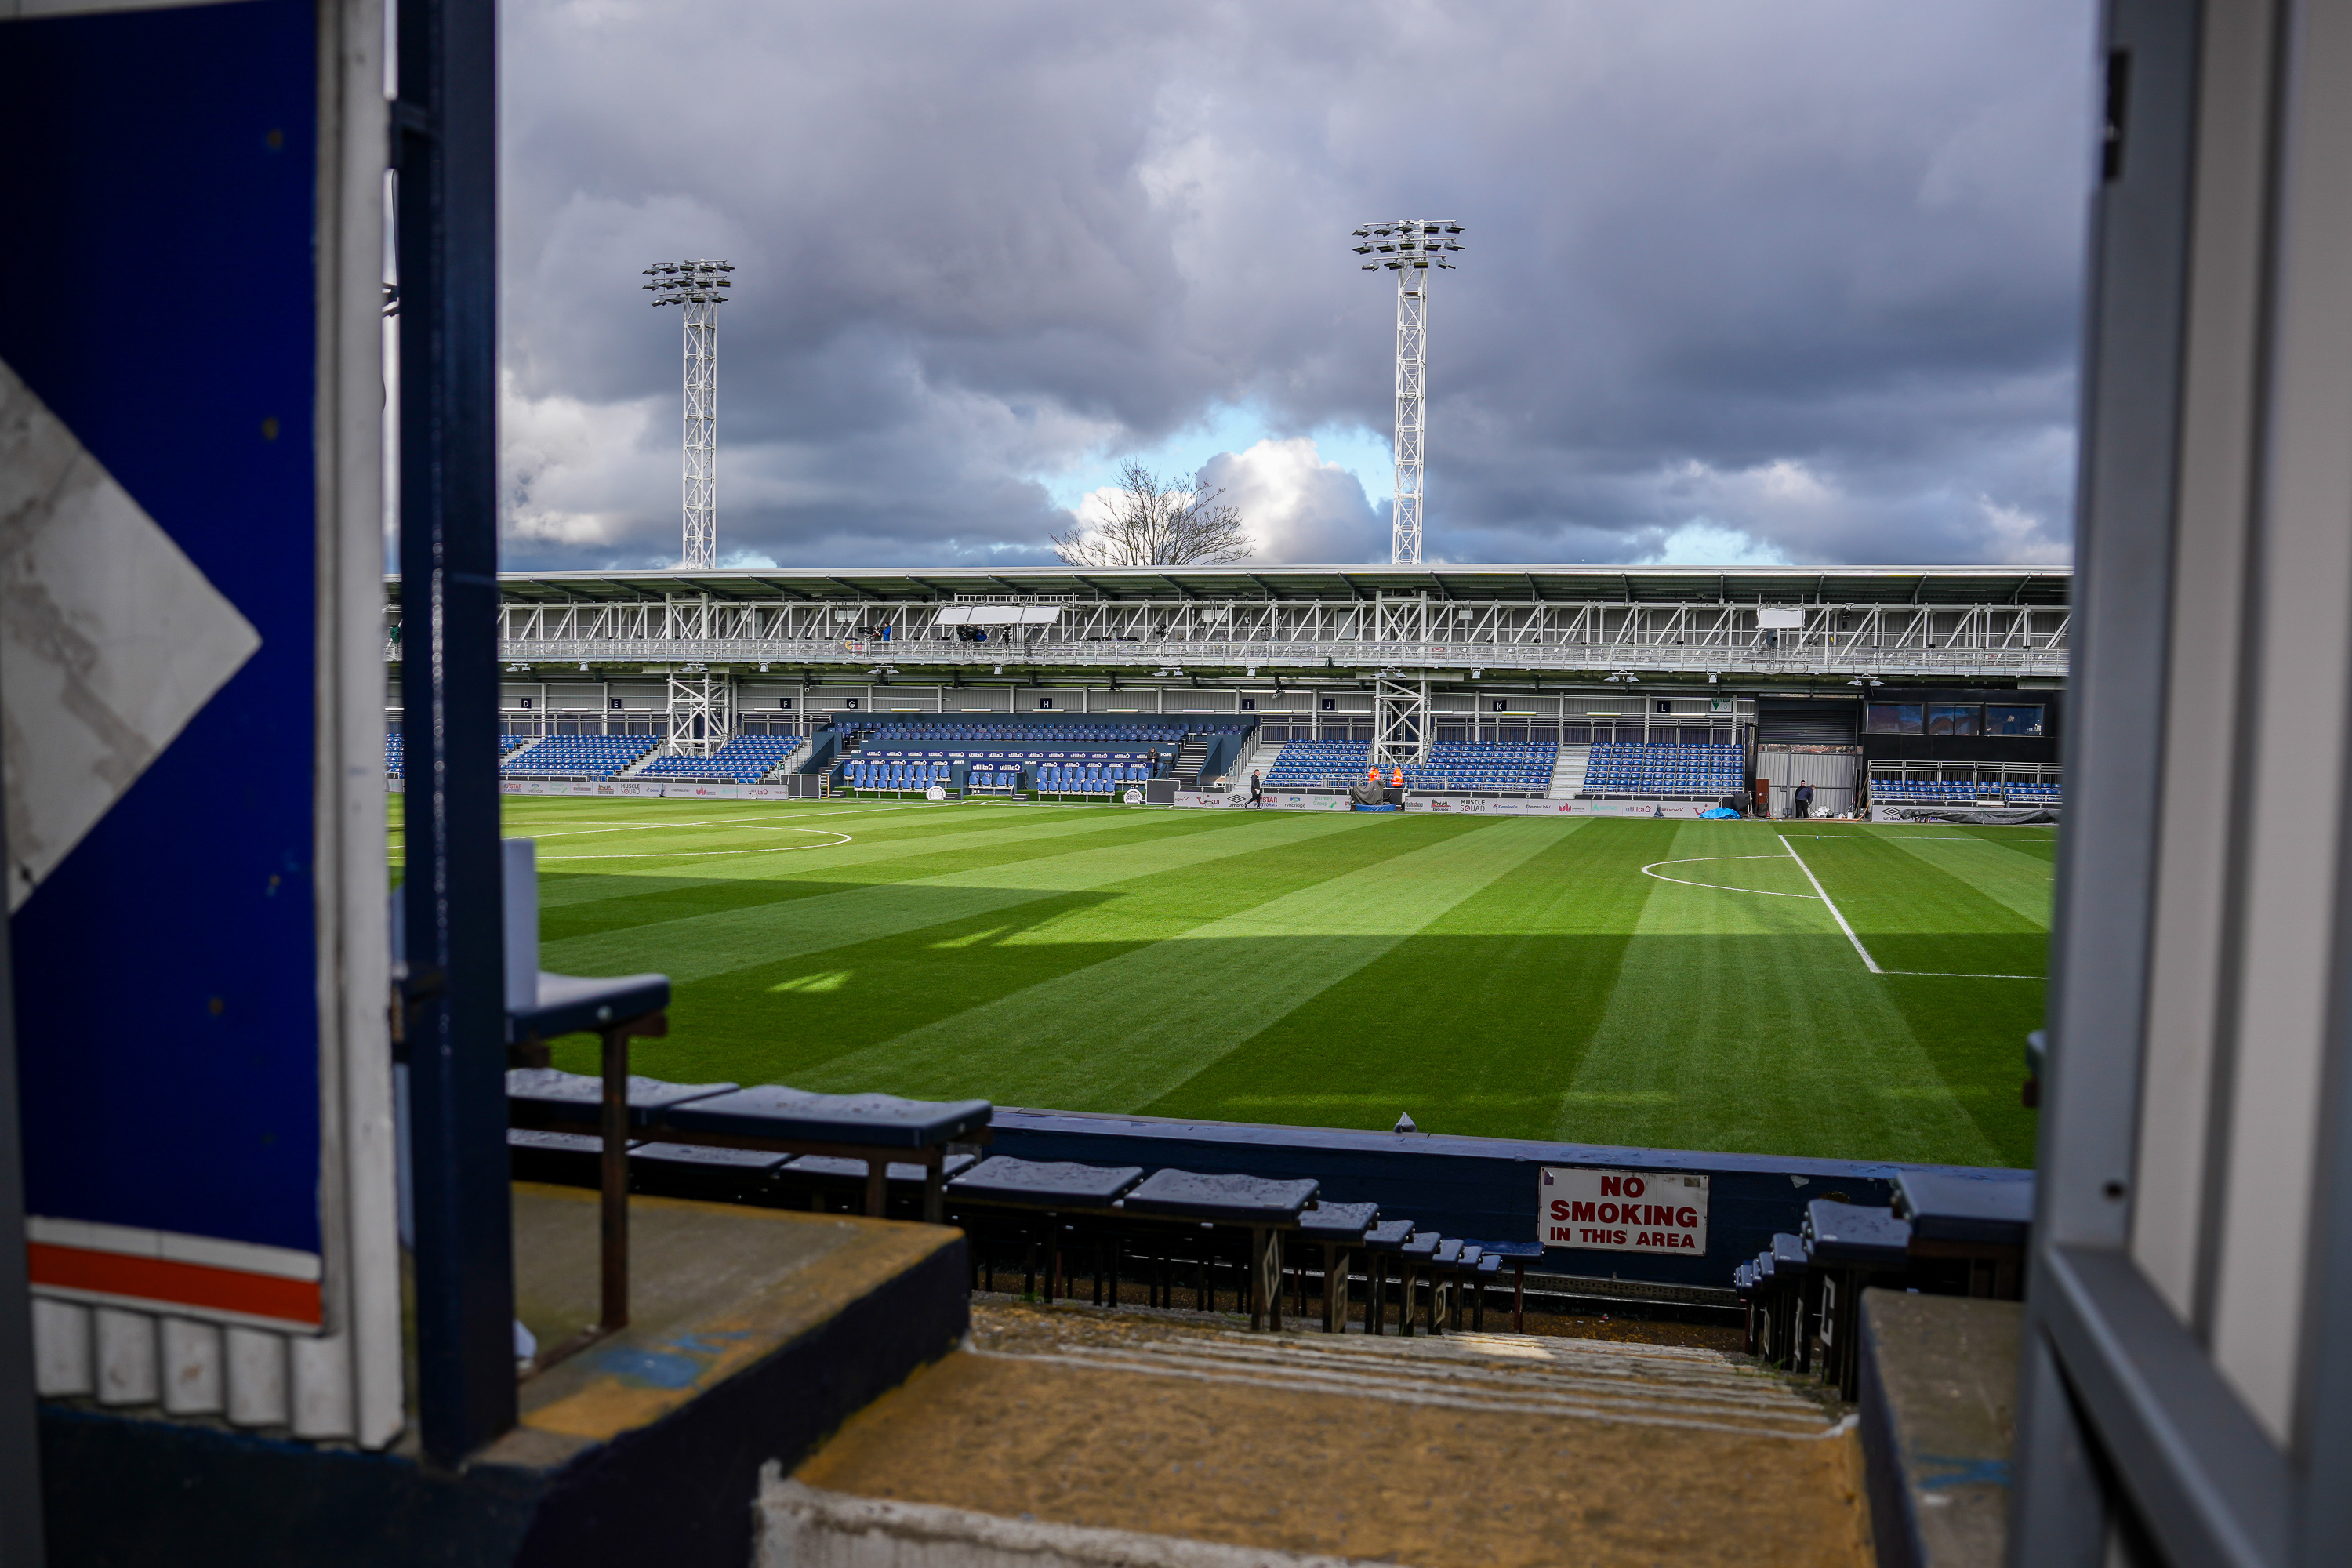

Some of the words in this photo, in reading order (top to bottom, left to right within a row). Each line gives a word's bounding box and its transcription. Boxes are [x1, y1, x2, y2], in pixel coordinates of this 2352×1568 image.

[1661, 703, 1666, 712] L
[1600, 1175, 1645, 1198] NO
[1550, 1200, 1697, 1228] SMOKING
[1550, 1226, 1570, 1242] IN
[1579, 1228, 1627, 1245] THIS
[1635, 1232, 1696, 1249] AREA
